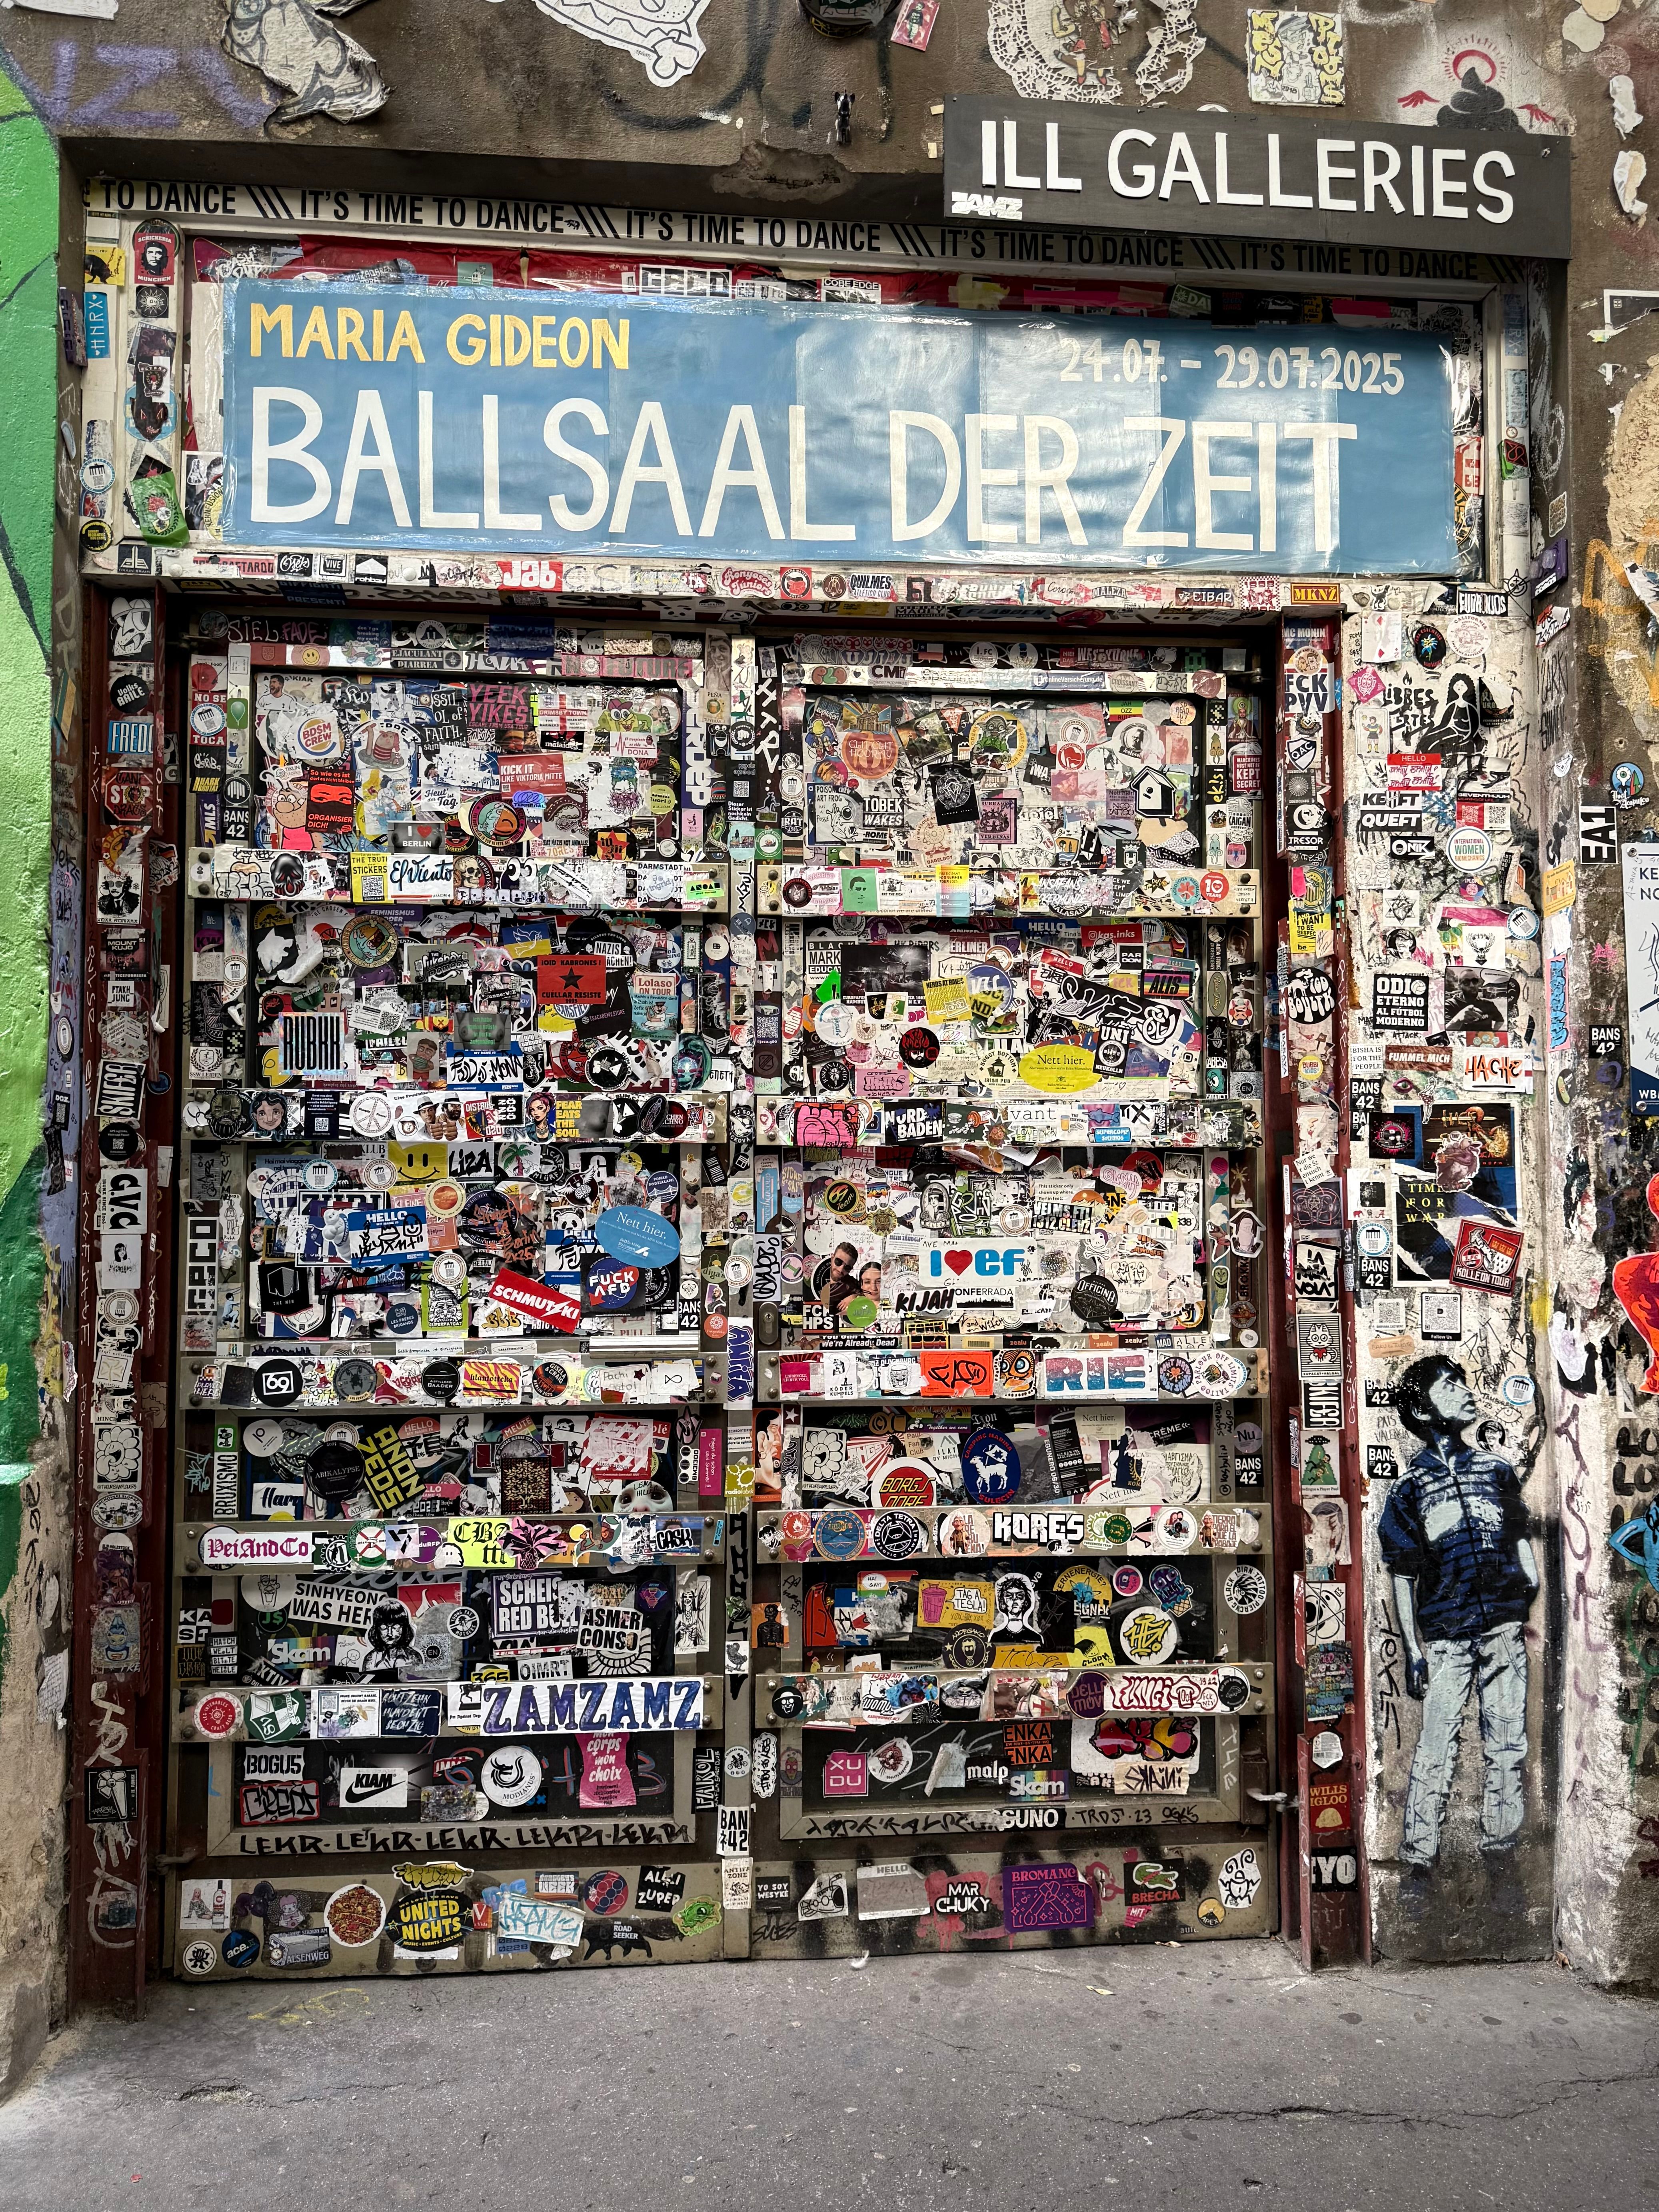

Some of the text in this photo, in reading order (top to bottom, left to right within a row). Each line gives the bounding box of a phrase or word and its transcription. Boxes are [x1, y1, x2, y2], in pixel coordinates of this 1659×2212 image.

[981, 120, 1515, 224] ILL GALLERIES
[101, 179, 1477, 280] TO DANCE IT'S TIME TO DANCE IT'S TIME TO DANCE IT'S TIME TO DANCE IT'S TIME TO DANCE
[853, 281, 879, 290] EDGE
[250, 303, 630, 370] MARIA GIDEON
[1060, 337, 1170, 384] 24.07.
[1215, 344, 1404, 396] 29.07.2025
[251, 387, 1357, 552] BALLSAAL DER ZEIT
[325, 558, 340, 569] VIVE
[850, 575, 891, 589] QUILMES
[1193, 591, 1231, 603] EIBAR
[1294, 585, 1337, 602] MKNŽ
[1286, 673, 1327, 691] FCK
[194, 693, 226, 702] NO SE
[469, 684, 528, 705] YEEK
[468, 703, 529, 723] YIKES
[302, 723, 331, 737] BDSM
[193, 735, 224, 745] TOCA
[305, 733, 332, 748] CREW
[501, 764, 534, 775] KICK IT
[1236, 769, 1260, 779] KEPT
[863, 798, 903, 812] TOBEK
[224, 811, 249, 823] BANS
[308, 814, 353, 823] ORGANISIER
[863, 813, 903, 826] WAKES
[1362, 813, 1420, 828] QUEFT
[226, 825, 245, 837] 42
[1455, 845, 1485, 855] WOMEN
[353, 865, 388, 874] STICKERS
[1301, 914, 1325, 924] WANT
[1097, 929, 1135, 940] kas.inks
[596, 943, 620, 955] NAZIS
[638, 978, 672, 987] Lolaso
[1151, 974, 1181, 995] ALIS
[1376, 996, 1424, 1007] ETERNO
[1391, 1007, 1425, 1017] FÚTBOL
[1376, 1017, 1425, 1027] MODERNO
[1101, 1027, 1128, 1043] UNI
[1592, 1029, 1620, 1040] BANS
[1037, 1054, 1085, 1065] Nett hier.
[1388, 1052, 1450, 1063] FUMMEL MICH
[1352, 1081, 1379, 1094] BANS
[1356, 1096, 1375, 1109] 42
[557, 1110, 581, 1119] EATS
[1011, 1107, 1055, 1120] vant
[557, 1120, 575, 1128] THE
[898, 1120, 942, 1140] BADEN
[557, 1129, 581, 1137] SOUL
[1405, 1197, 1445, 1208] FOR
[617, 1212, 667, 1240] Nett hier.
[975, 1249, 1025, 1276] ef
[1361, 1259, 1388, 1273] BANS
[589, 1271, 635, 1287] FUCK
[1365, 1274, 1384, 1287] 42
[822, 1338, 843, 1347] We're
[841, 1338, 870, 1347] Already
[1099, 1413, 1115, 1421] hier.
[1369, 1448, 1395, 1461] BANS
[1235, 1457, 1261, 1470] BANS
[1373, 1463, 1391, 1476] 42
[315, 1465, 360, 1479] ABIKALYPSE
[1239, 1472, 1257, 1484] 42
[215, 1454, 238, 1515] BRUXISMO
[994, 1512, 1083, 1544] KORES
[955, 1589, 980, 1600] TAG A
[292, 1599, 331, 1619] WAS
[955, 1599, 986, 1612] TESLA!
[500, 1607, 534, 1632] RED
[482, 1681, 702, 1734] ZAMZAMZ
[1004, 1724, 1051, 1741] ENKA
[589, 1766, 622, 1782] choix
[1310, 1784, 1347, 1796] WILLS
[947, 1884, 978, 1896] MAR
[936, 1896, 990, 1913] CHUKY
[1131, 1892, 1180, 1904] BRECHA
[401, 1900, 459, 1922] UNITED
[402, 1917, 462, 1940] NIGHTS
